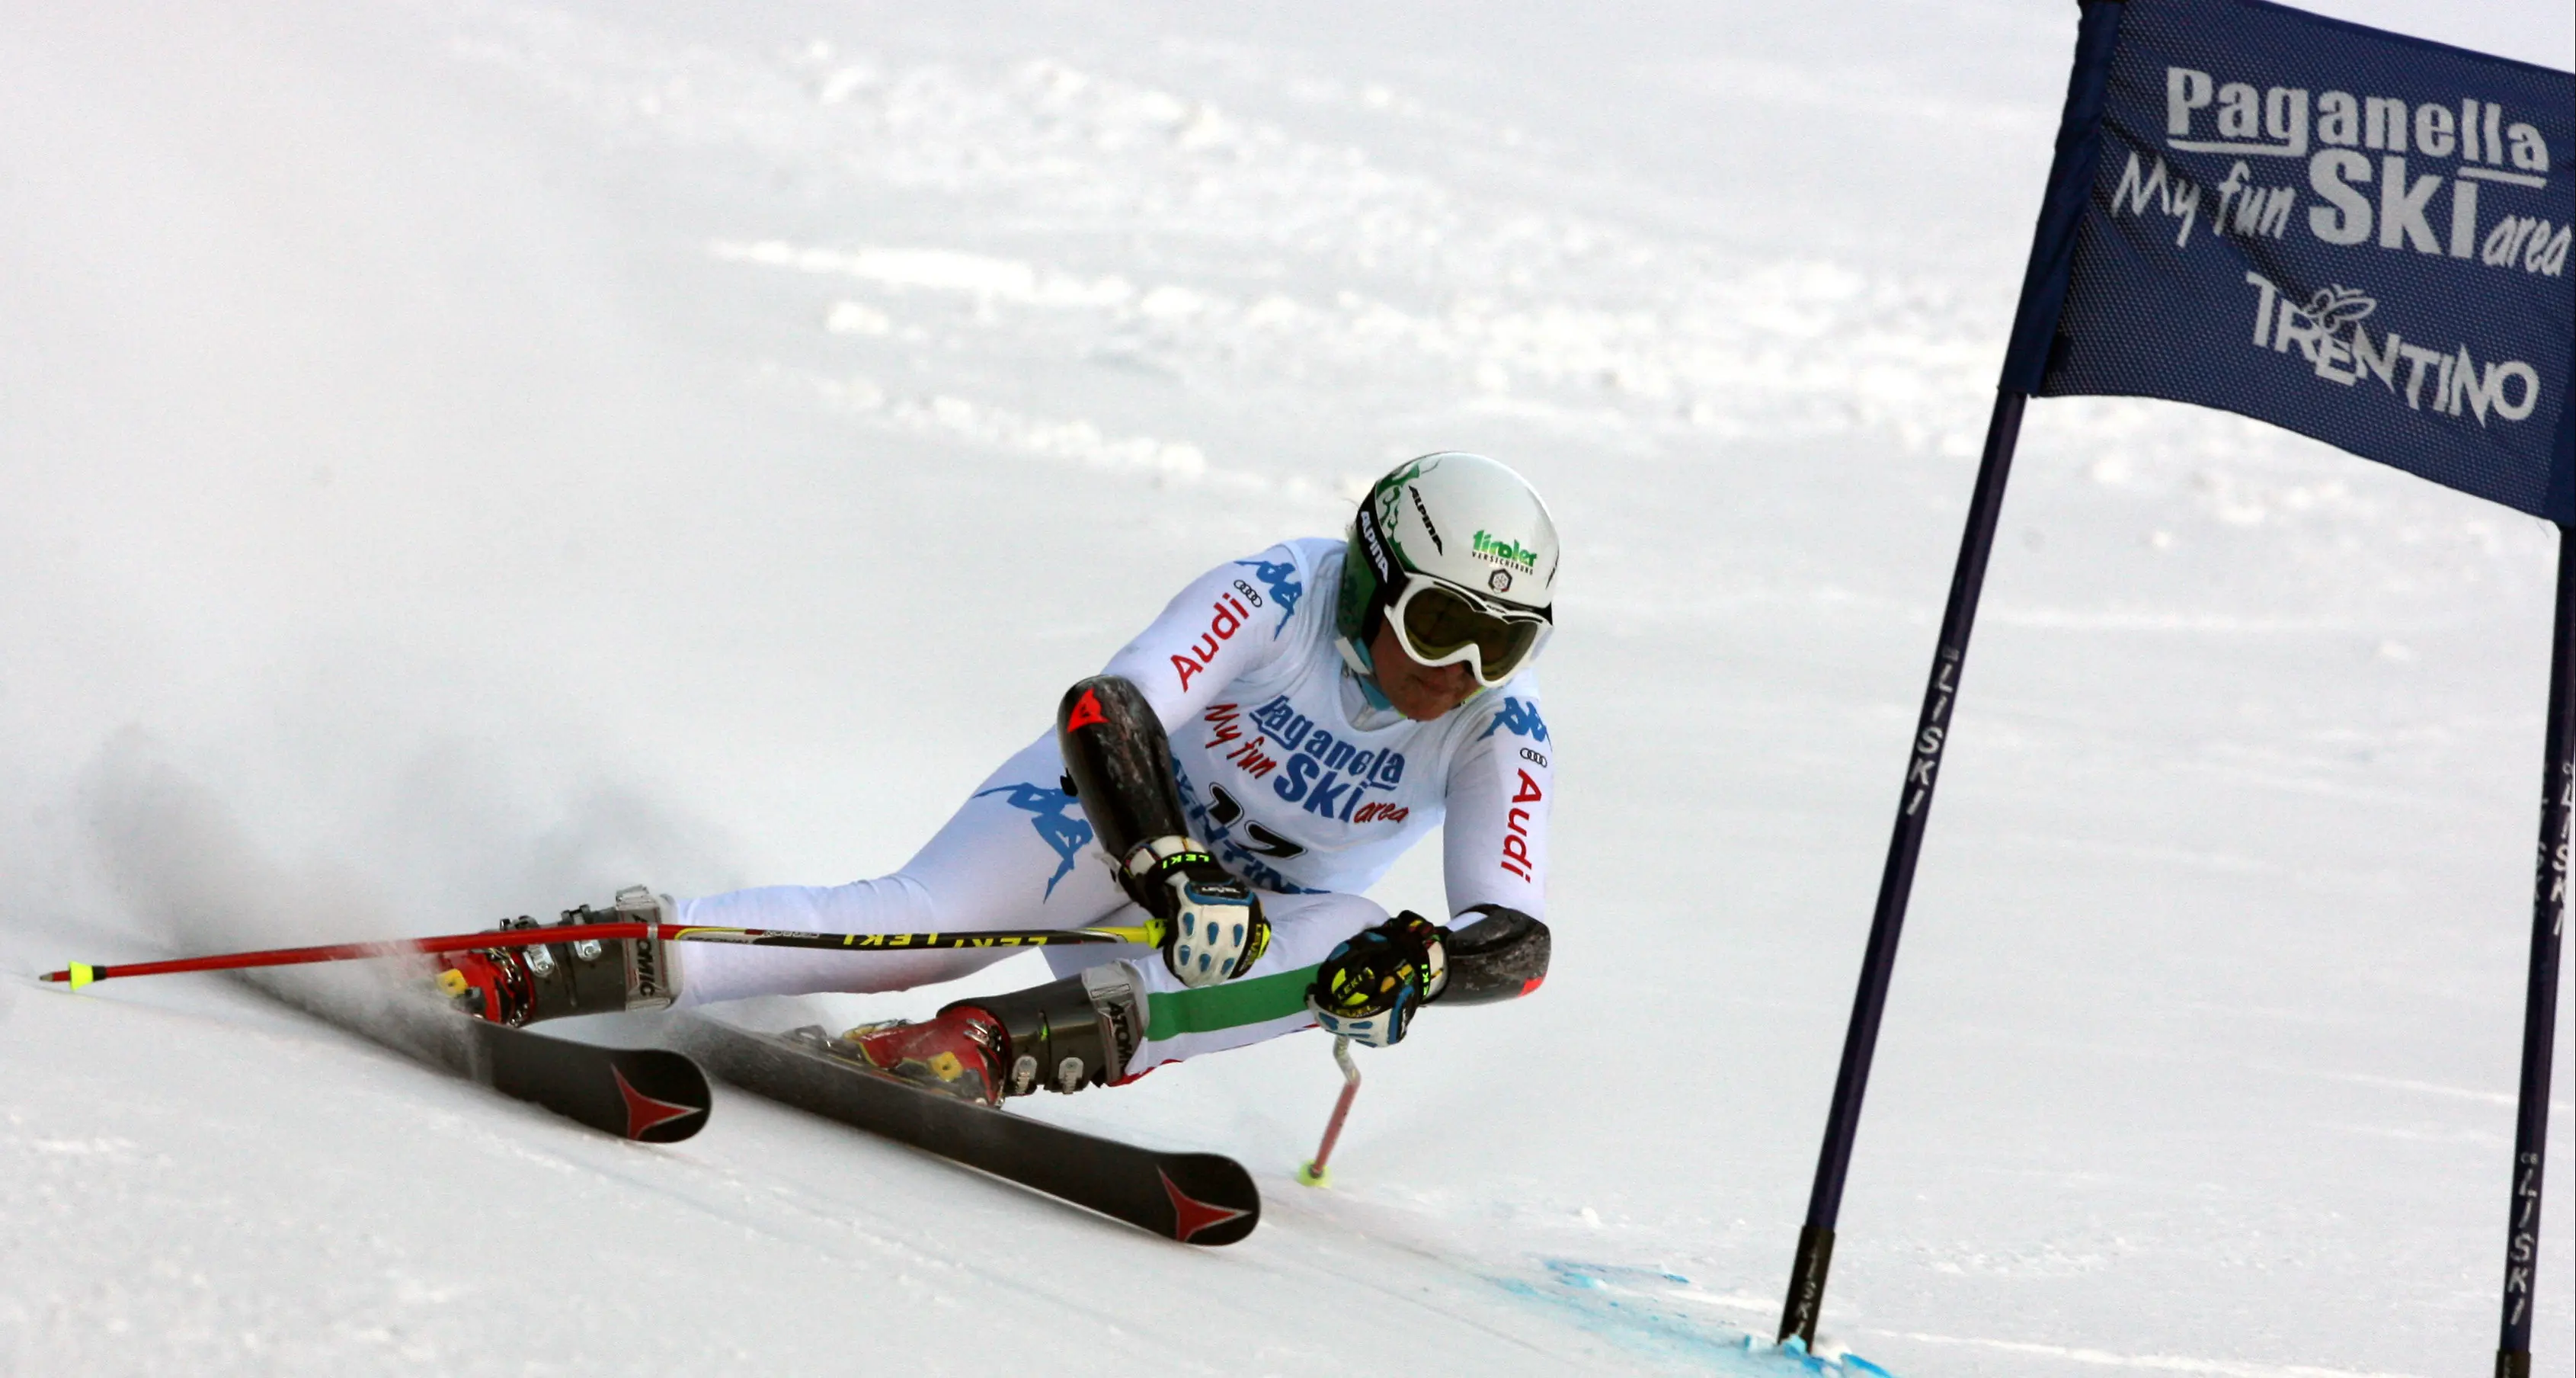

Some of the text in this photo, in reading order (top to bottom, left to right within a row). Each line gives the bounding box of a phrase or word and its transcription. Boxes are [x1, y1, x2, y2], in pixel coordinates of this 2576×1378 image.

[2168, 66, 2549, 174] Paganella
[2111, 151, 2200, 248] My
[2213, 160, 2296, 239] fun
[2483, 213, 2573, 277] area
[2246, 271, 2540, 428] TRENTINO
[1473, 530, 1538, 567] tiroler
[1170, 592, 1250, 693] Audi
[1205, 703, 1243, 748] My
[1226, 735, 1277, 779] fun
[1354, 802, 1410, 824] area
[1906, 664, 1954, 816] LISKI
[1162, 854, 1210, 870] LEKI
[1500, 768, 1542, 884] Audi
[2507, 1168, 2538, 1326] LISKI
